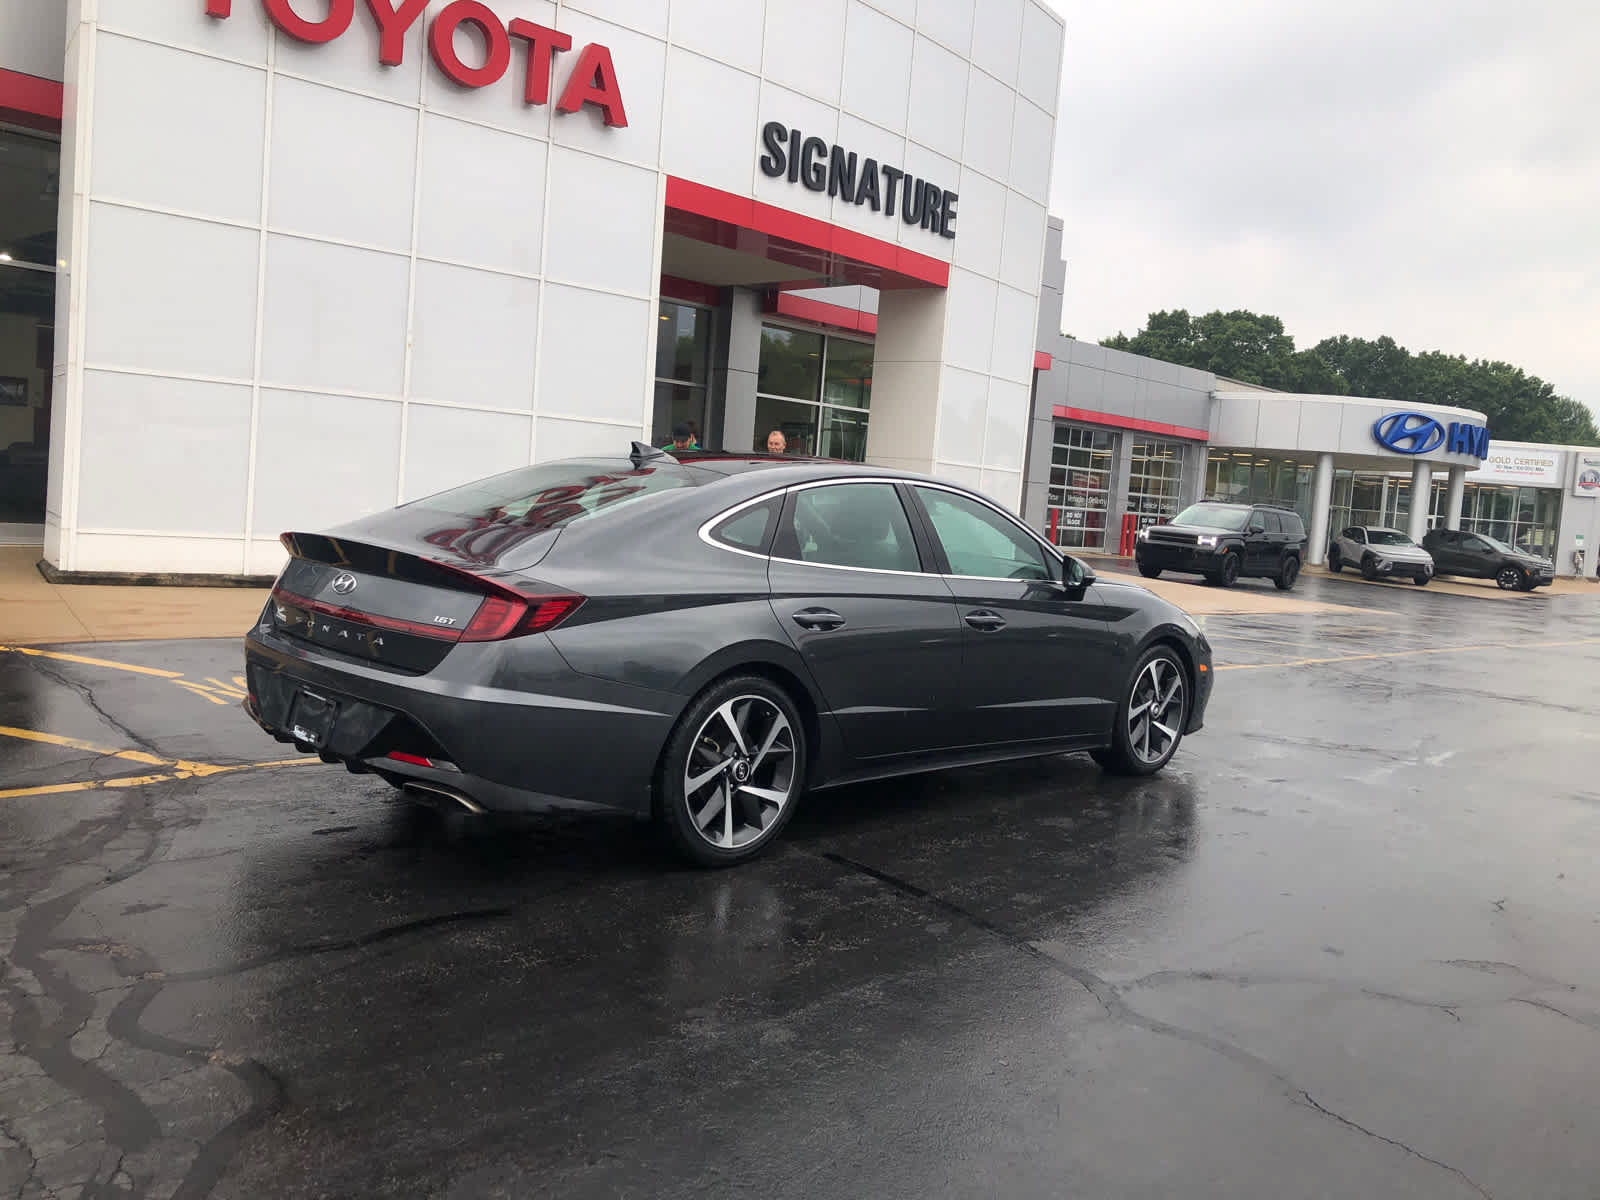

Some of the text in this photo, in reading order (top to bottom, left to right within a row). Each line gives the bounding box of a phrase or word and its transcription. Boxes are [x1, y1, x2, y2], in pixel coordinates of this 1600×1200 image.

[205, 0, 628, 128] YOTA
[760, 121, 960, 240] SIGNATURE
[1488, 456, 1511, 464] GOLD
